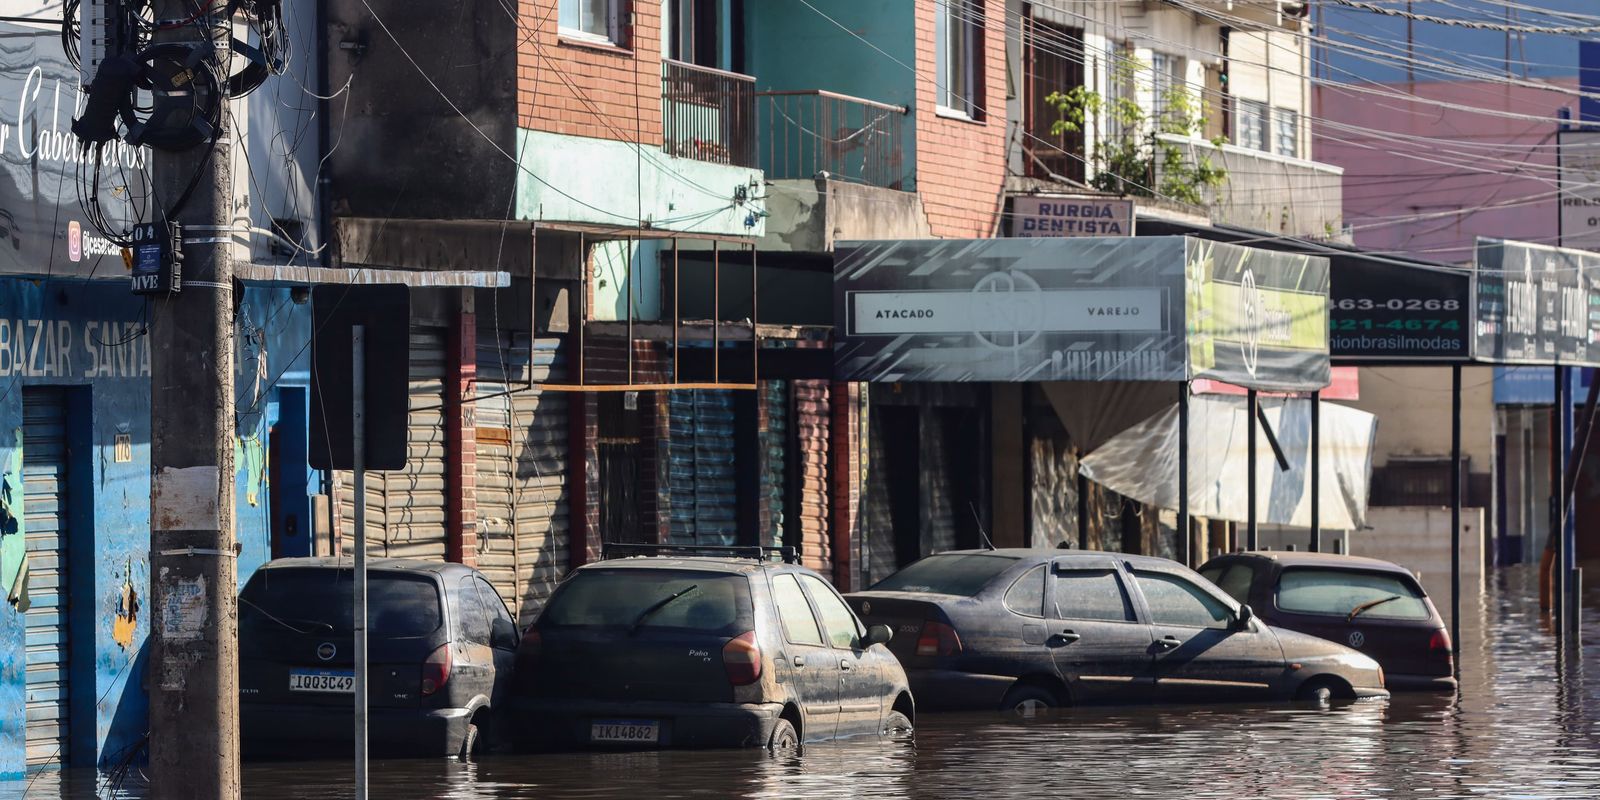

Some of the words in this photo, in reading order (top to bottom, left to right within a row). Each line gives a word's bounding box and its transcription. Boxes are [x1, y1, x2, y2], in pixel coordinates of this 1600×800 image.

[19, 66, 145, 169] Cabeleiros
[1024, 218, 1121, 234] DENTISTA
[876, 309, 934, 319] ATACADO
[1087, 307, 1140, 316] VAREJO
[0, 319, 71, 376] BAZAR
[84, 321, 151, 377] SANTA
[689, 649, 708, 657] Palio
[296, 676, 353, 690] IQQ3C49
[597, 726, 652, 739] IKI4B62
